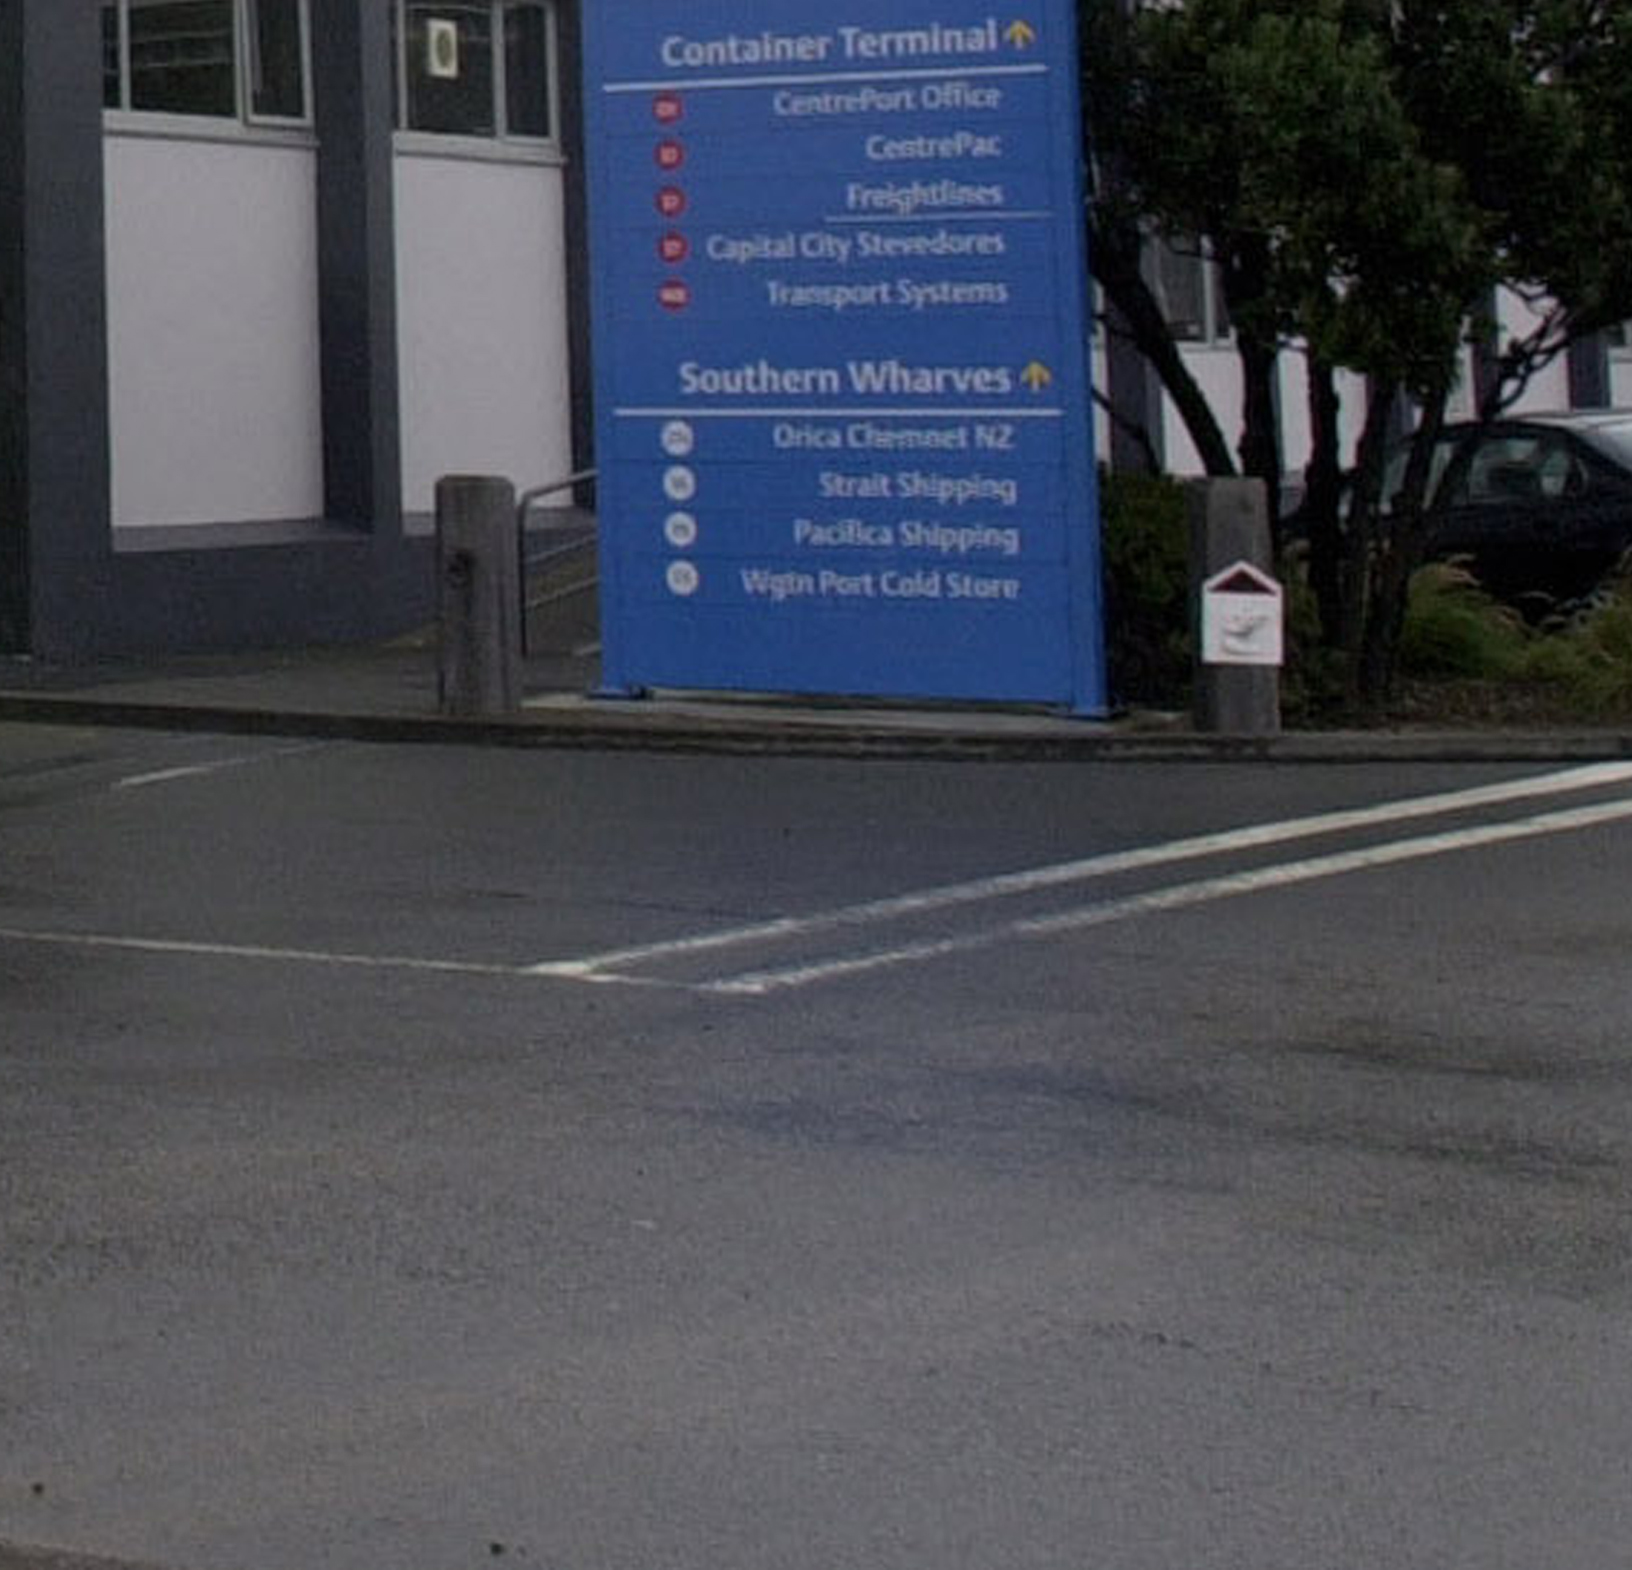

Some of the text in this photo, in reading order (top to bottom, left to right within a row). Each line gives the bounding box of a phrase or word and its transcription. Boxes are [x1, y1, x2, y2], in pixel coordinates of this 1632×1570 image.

[661, 19, 998, 67] Container Terminal
[773, 82, 1001, 114] CentrePort Office
[865, 132, 1002, 160] CentrePac
[846, 179, 1004, 214] Freightlines
[706, 231, 795, 266] Capital
[800, 233, 851, 264] City
[857, 229, 1006, 256] Stevedores
[767, 277, 1008, 308] Transport Systems
[679, 361, 1012, 394] Southern Wharves
[975, 424, 1016, 449] NZ
[818, 470, 1018, 506] Strait Shipping
[793, 518, 1020, 555] Pacifica Shipping
[818, 569, 873, 596] Port
[880, 570, 940, 598] Cold
[946, 572, 1022, 599] Store
